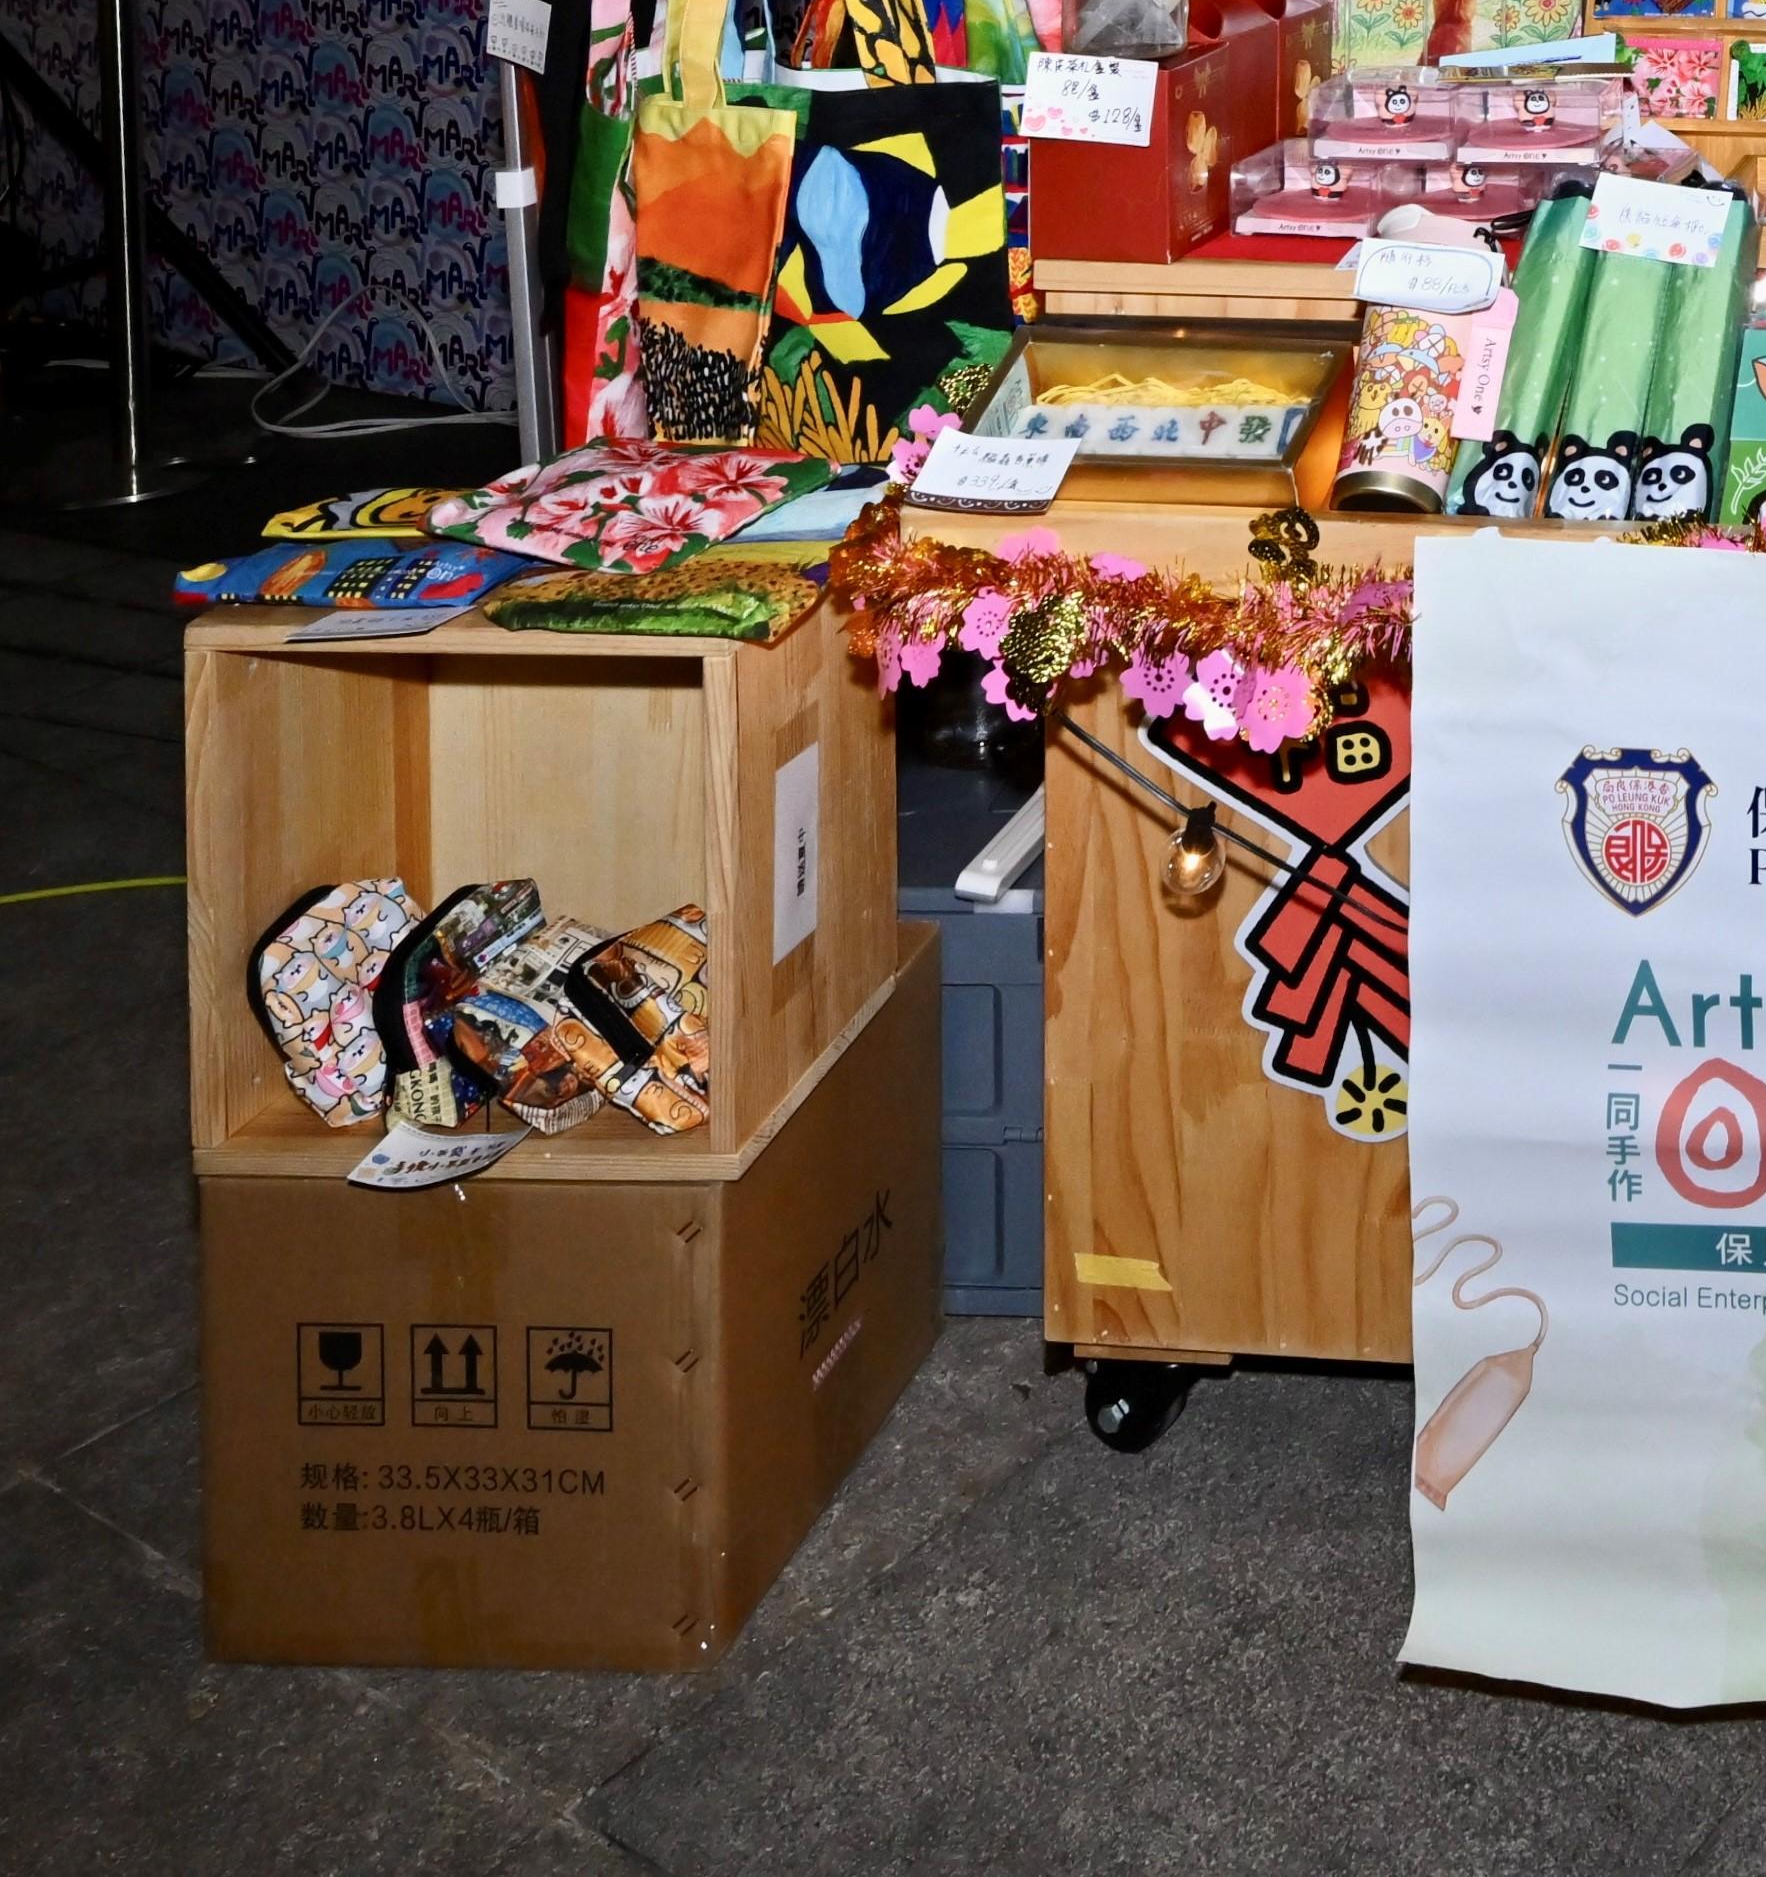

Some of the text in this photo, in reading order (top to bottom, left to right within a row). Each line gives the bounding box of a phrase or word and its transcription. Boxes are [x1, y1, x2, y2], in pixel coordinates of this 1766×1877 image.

[1473, 337, 1497, 402] Artsy One
[1602, 792, 1671, 806] PO LEUNG KUK
[1612, 803, 1661, 813] HONG KONG
[1605, 1063, 1644, 1204] 一同手作
[799, 1187, 894, 1361] 漂白水
[1613, 1284, 1688, 1309] Social
[307, 1402, 377, 1422] 小心轻放
[433, 1405, 475, 1422] 向上
[301, 1462, 606, 1495] 规格: 33.5X33X31CM
[301, 1500, 541, 1536] 数量:3.8LX4瓶/箱
